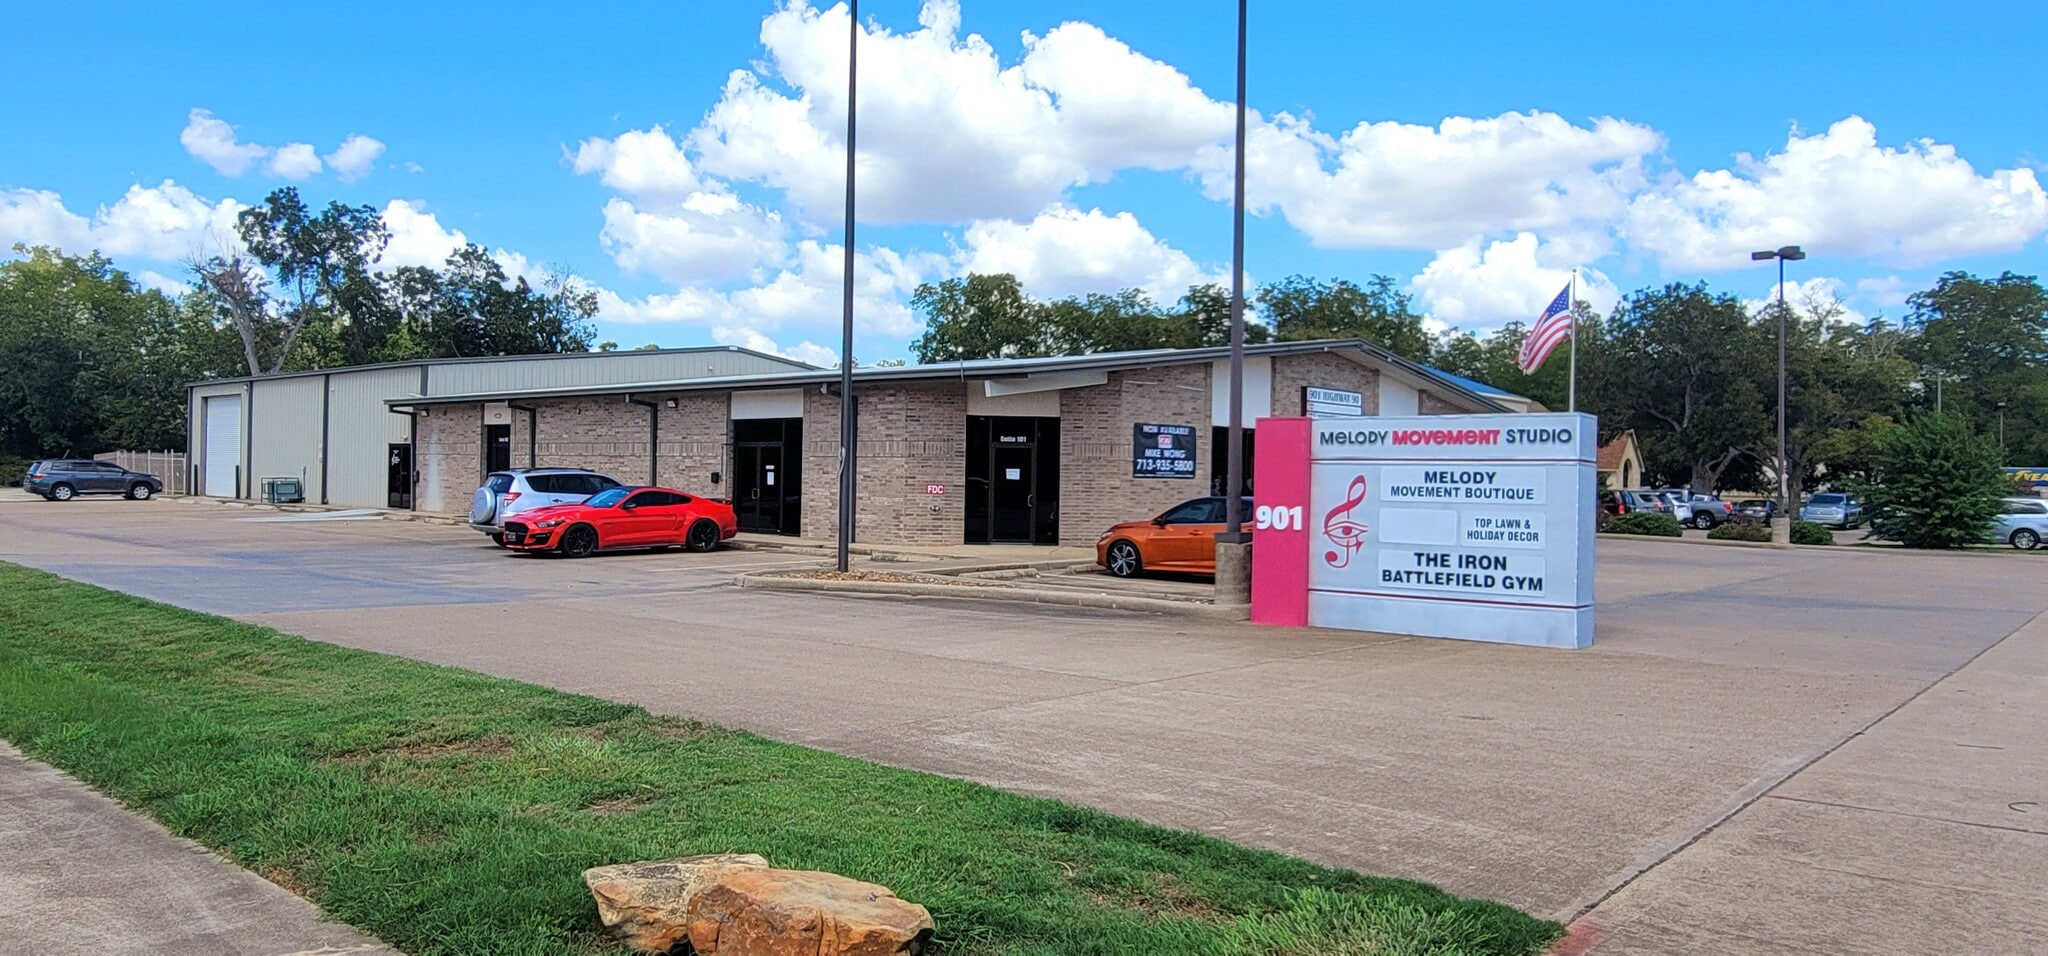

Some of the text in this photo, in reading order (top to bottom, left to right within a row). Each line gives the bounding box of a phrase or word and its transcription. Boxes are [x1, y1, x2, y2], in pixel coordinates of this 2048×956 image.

[1506, 429, 1573, 444] STUDIO
[1144, 448, 1186, 459] MIKE WONG
[1424, 471, 1497, 484] MELODY
[927, 485, 944, 494] FDC
[1390, 485, 1535, 500] MOVEMENT BOUTIQUE
[1255, 504, 1303, 531] 901
[1474, 518, 1531, 530] TOP LAWN &
[1467, 530, 1539, 543] HOLIDAY DECOR
[1413, 552, 1508, 572] THE IRON
[1381, 569, 1543, 592] BATTLEFIELD GYM
